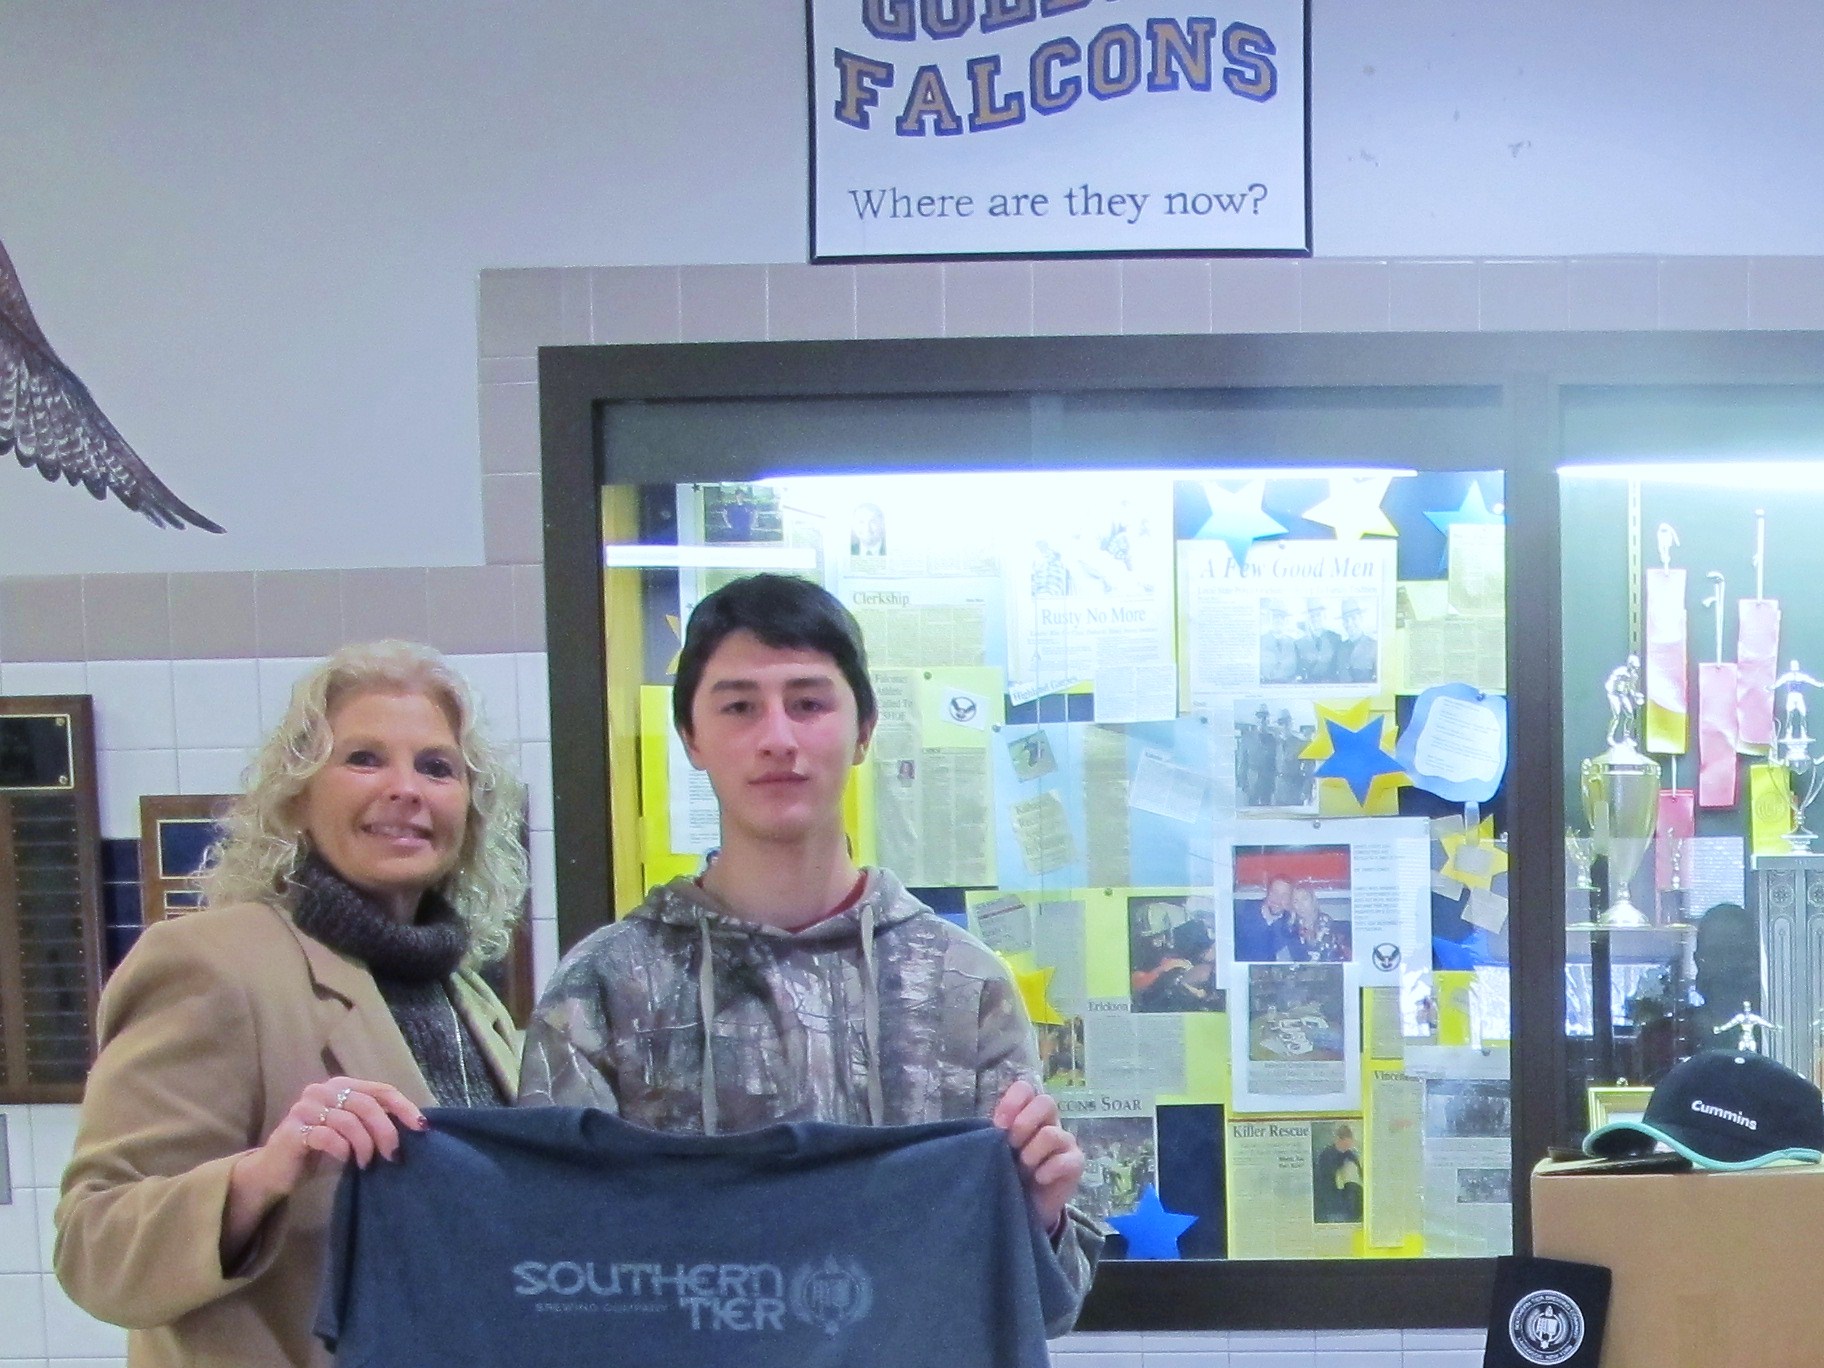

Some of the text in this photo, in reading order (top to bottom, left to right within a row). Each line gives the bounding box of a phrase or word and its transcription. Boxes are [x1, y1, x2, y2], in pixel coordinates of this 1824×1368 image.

[834, 17, 1278, 136] FALCONS
[850, 183, 1268, 224] Where are they now?
[1200, 559, 1215, 578] A
[1272, 557, 1325, 578] Good
[1330, 557, 1374, 578] Men
[853, 591, 910, 606] Clerkship
[1041, 606, 1145, 629] Rusty No More
[1057, 1100, 1096, 1111] CONS
[1691, 1100, 1757, 1131] Cummins
[1233, 1125, 1309, 1137] Killer Rescue
[512, 1260, 783, 1297] SOUTHERN
[679, 1296, 785, 1331] TIER
